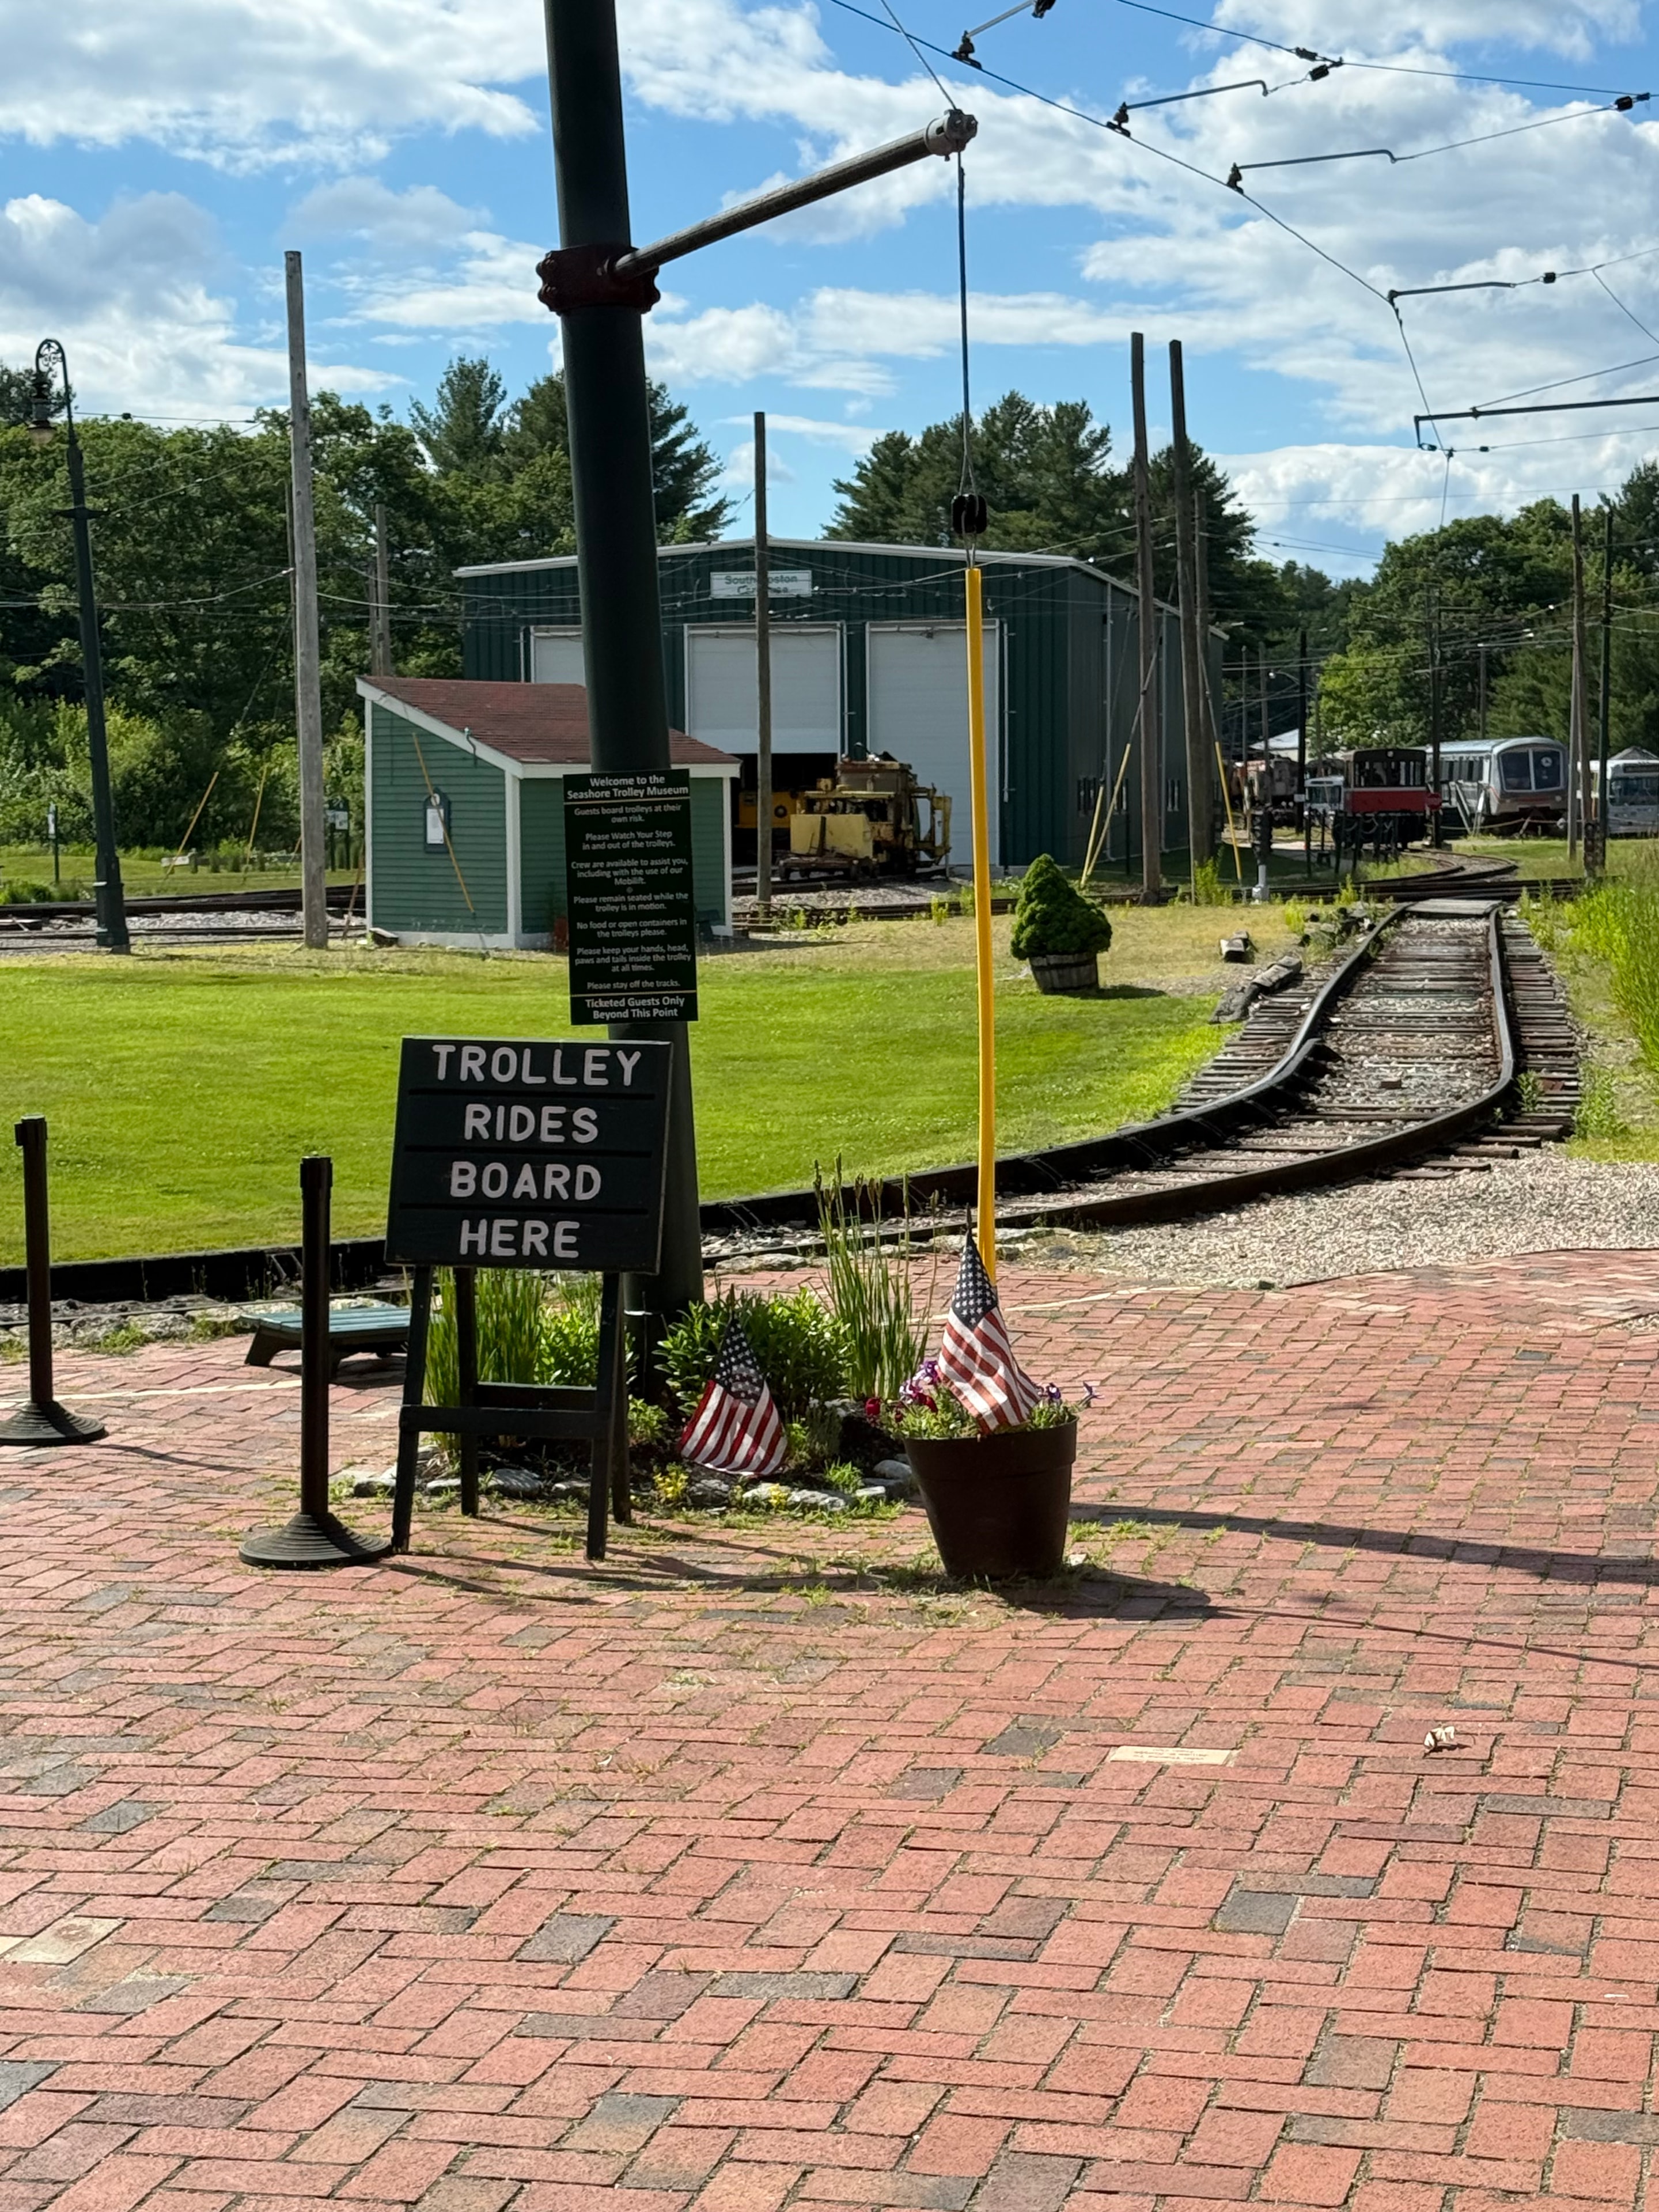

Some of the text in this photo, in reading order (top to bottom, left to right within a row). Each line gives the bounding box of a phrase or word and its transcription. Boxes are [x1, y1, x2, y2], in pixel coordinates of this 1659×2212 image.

[725, 575, 756, 585] South
[590, 777, 634, 787] Welcome
[649, 775, 665, 784] the
[567, 787, 688, 799] Seashore Trolley Museum
[625, 805, 653, 813] trolleys
[655, 830, 672, 839] Step
[646, 840, 675, 848] trolleys.
[606, 859, 639, 868] available
[577, 870, 611, 878] including
[641, 929, 666, 937] please.
[641, 945, 665, 953] hands,
[575, 957, 594, 965] paws
[628, 954, 651, 962] inside
[667, 953, 691, 961] trolley
[613, 981, 627, 989] stay
[585, 996, 685, 1007] Ticketed Guests Only
[593, 1008, 678, 1020] Beyond This Point
[432, 1045, 641, 1086] TROLLEY
[464, 1104, 598, 1143] RIDES
[450, 1161, 601, 1200] BOARD
[460, 1218, 580, 1258] HERE
